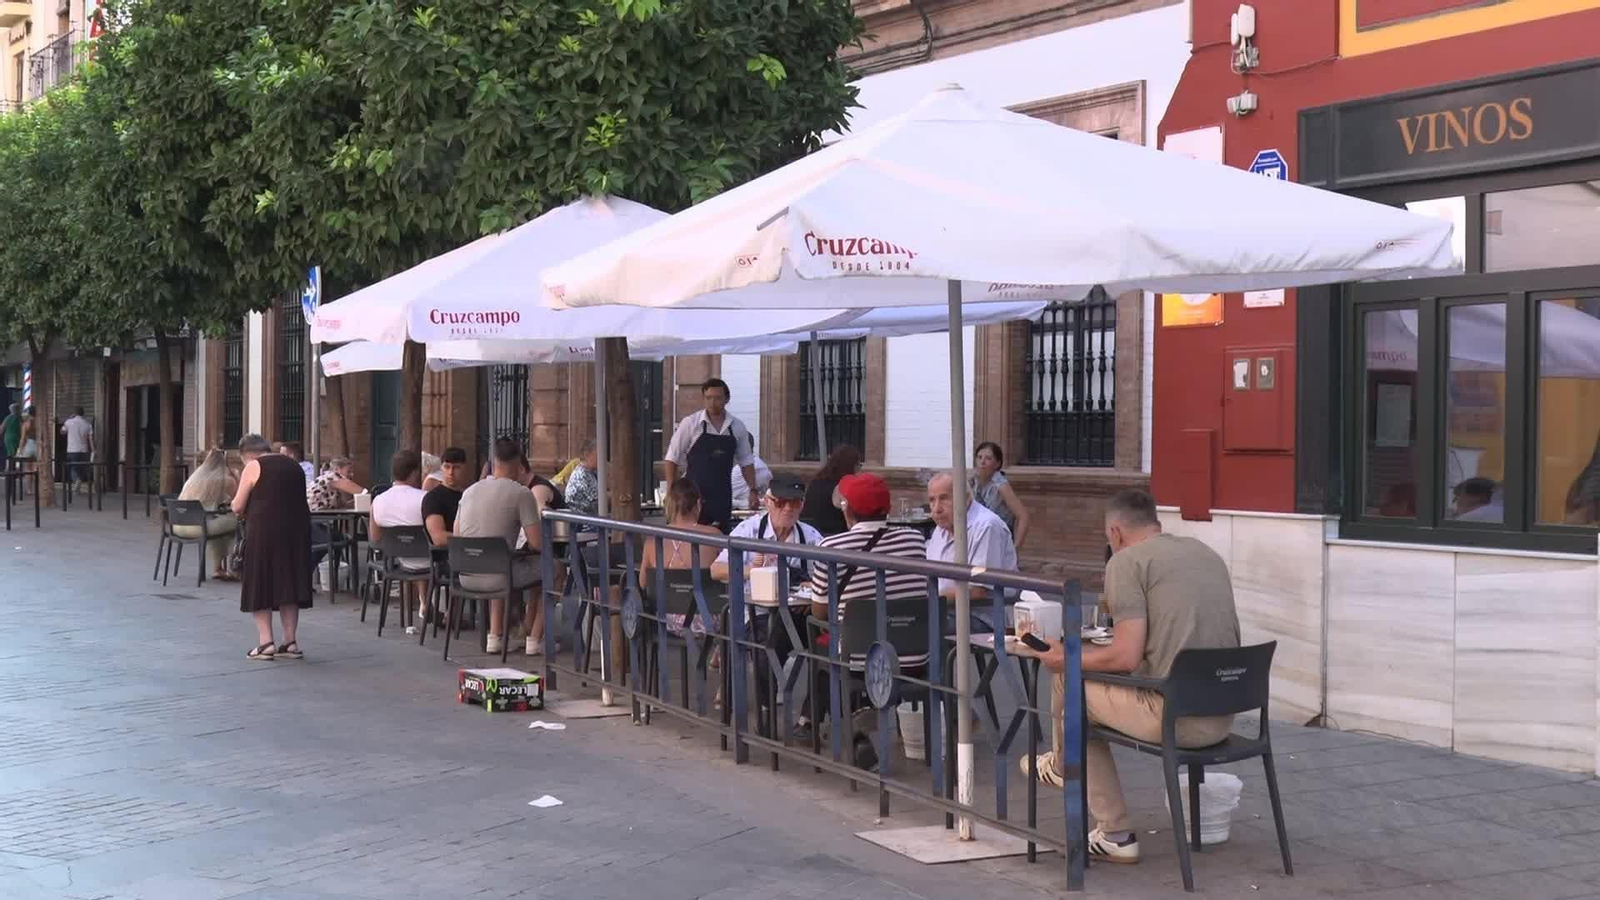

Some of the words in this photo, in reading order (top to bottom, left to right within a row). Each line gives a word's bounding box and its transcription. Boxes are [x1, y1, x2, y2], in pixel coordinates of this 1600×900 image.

[1396, 97, 1534, 156] VINOS
[804, 230, 918, 259] Cruzcam
[832, 260, 870, 271] DESDE
[429, 308, 520, 327] Cruzcampo
